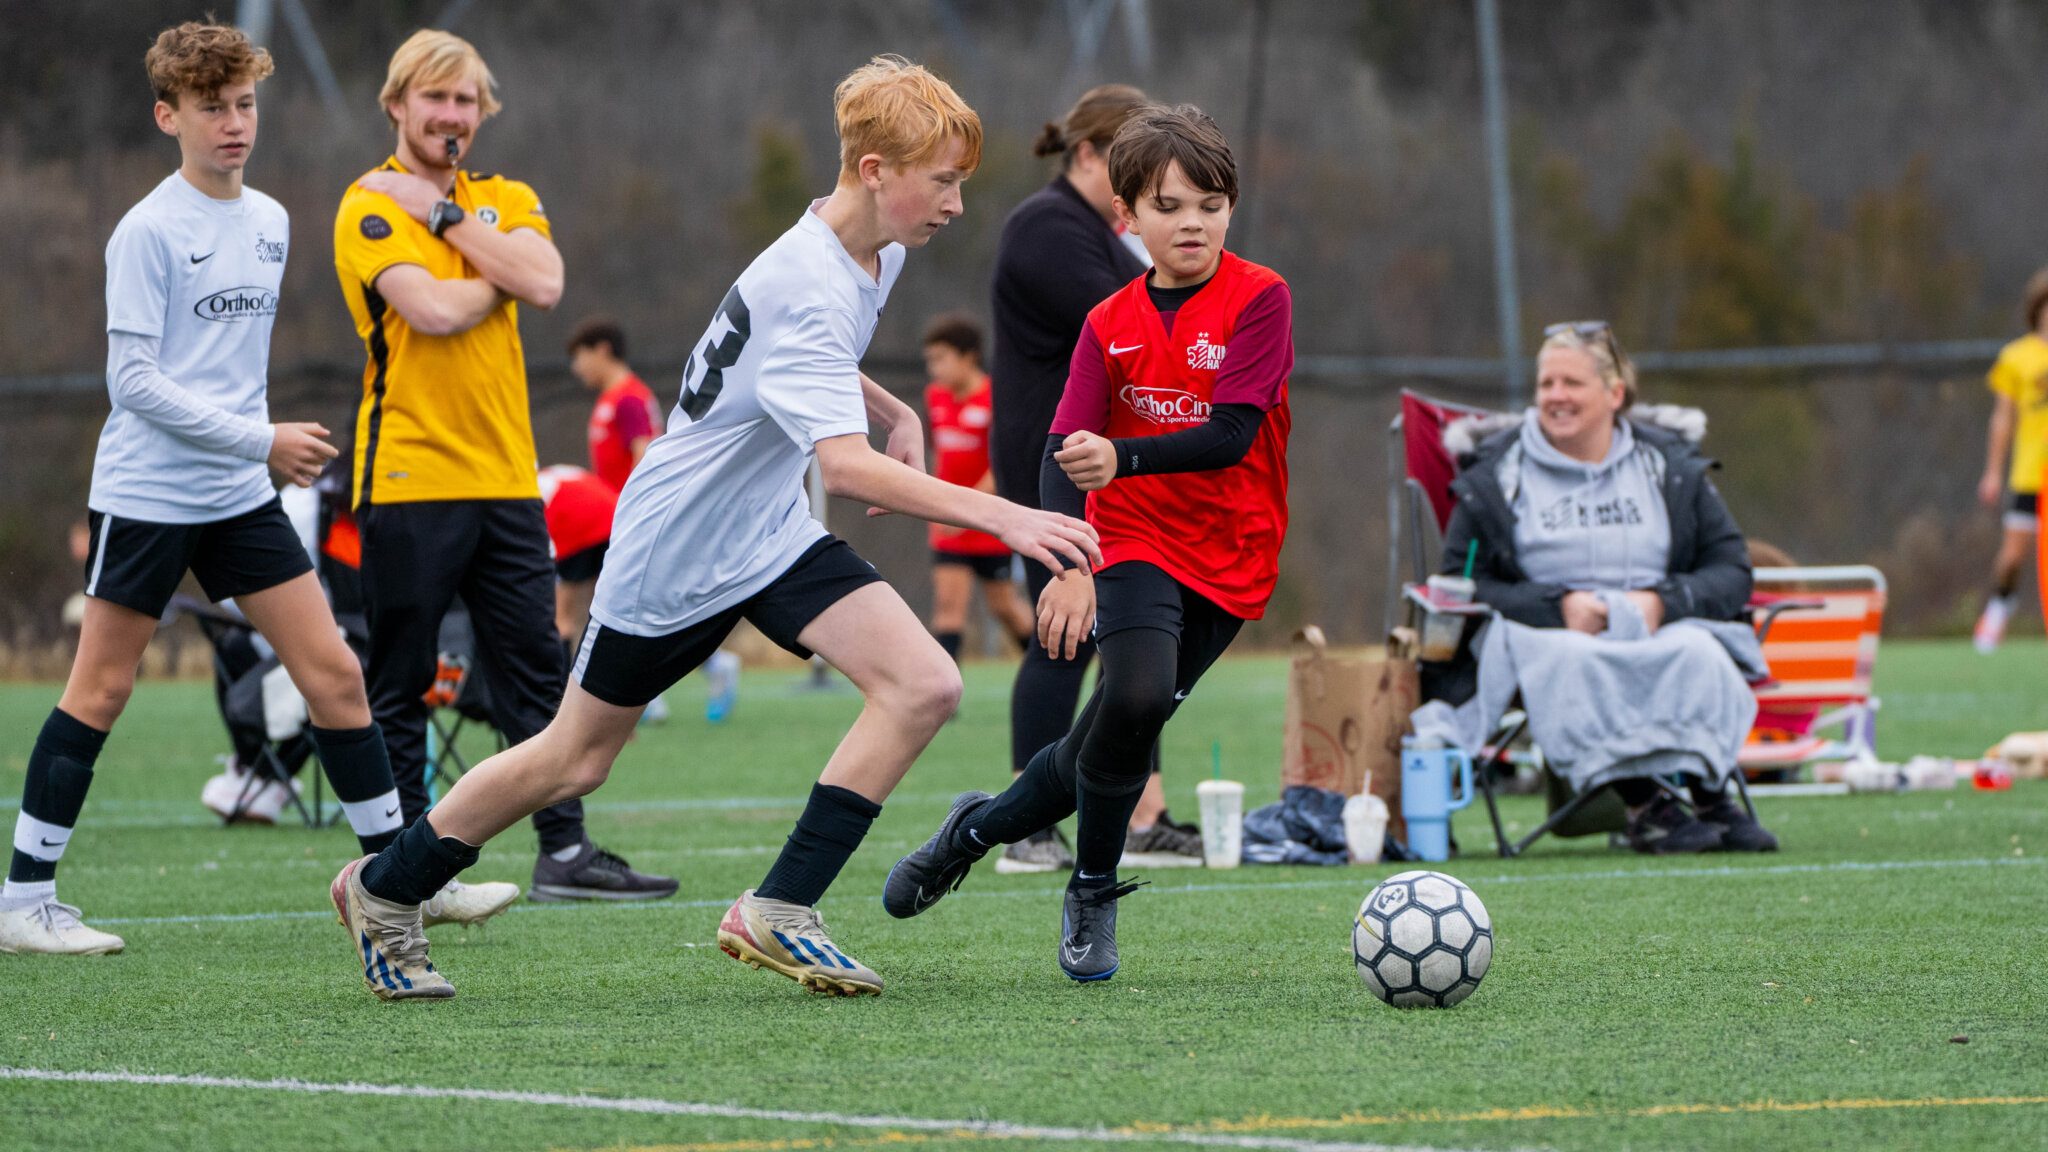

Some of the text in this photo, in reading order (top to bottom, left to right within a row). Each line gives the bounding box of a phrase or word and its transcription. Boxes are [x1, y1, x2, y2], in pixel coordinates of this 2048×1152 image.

[679, 284, 751, 423] 3
[1131, 388, 1213, 416] OrthoCin
[1167, 416, 1189, 424] Sports
